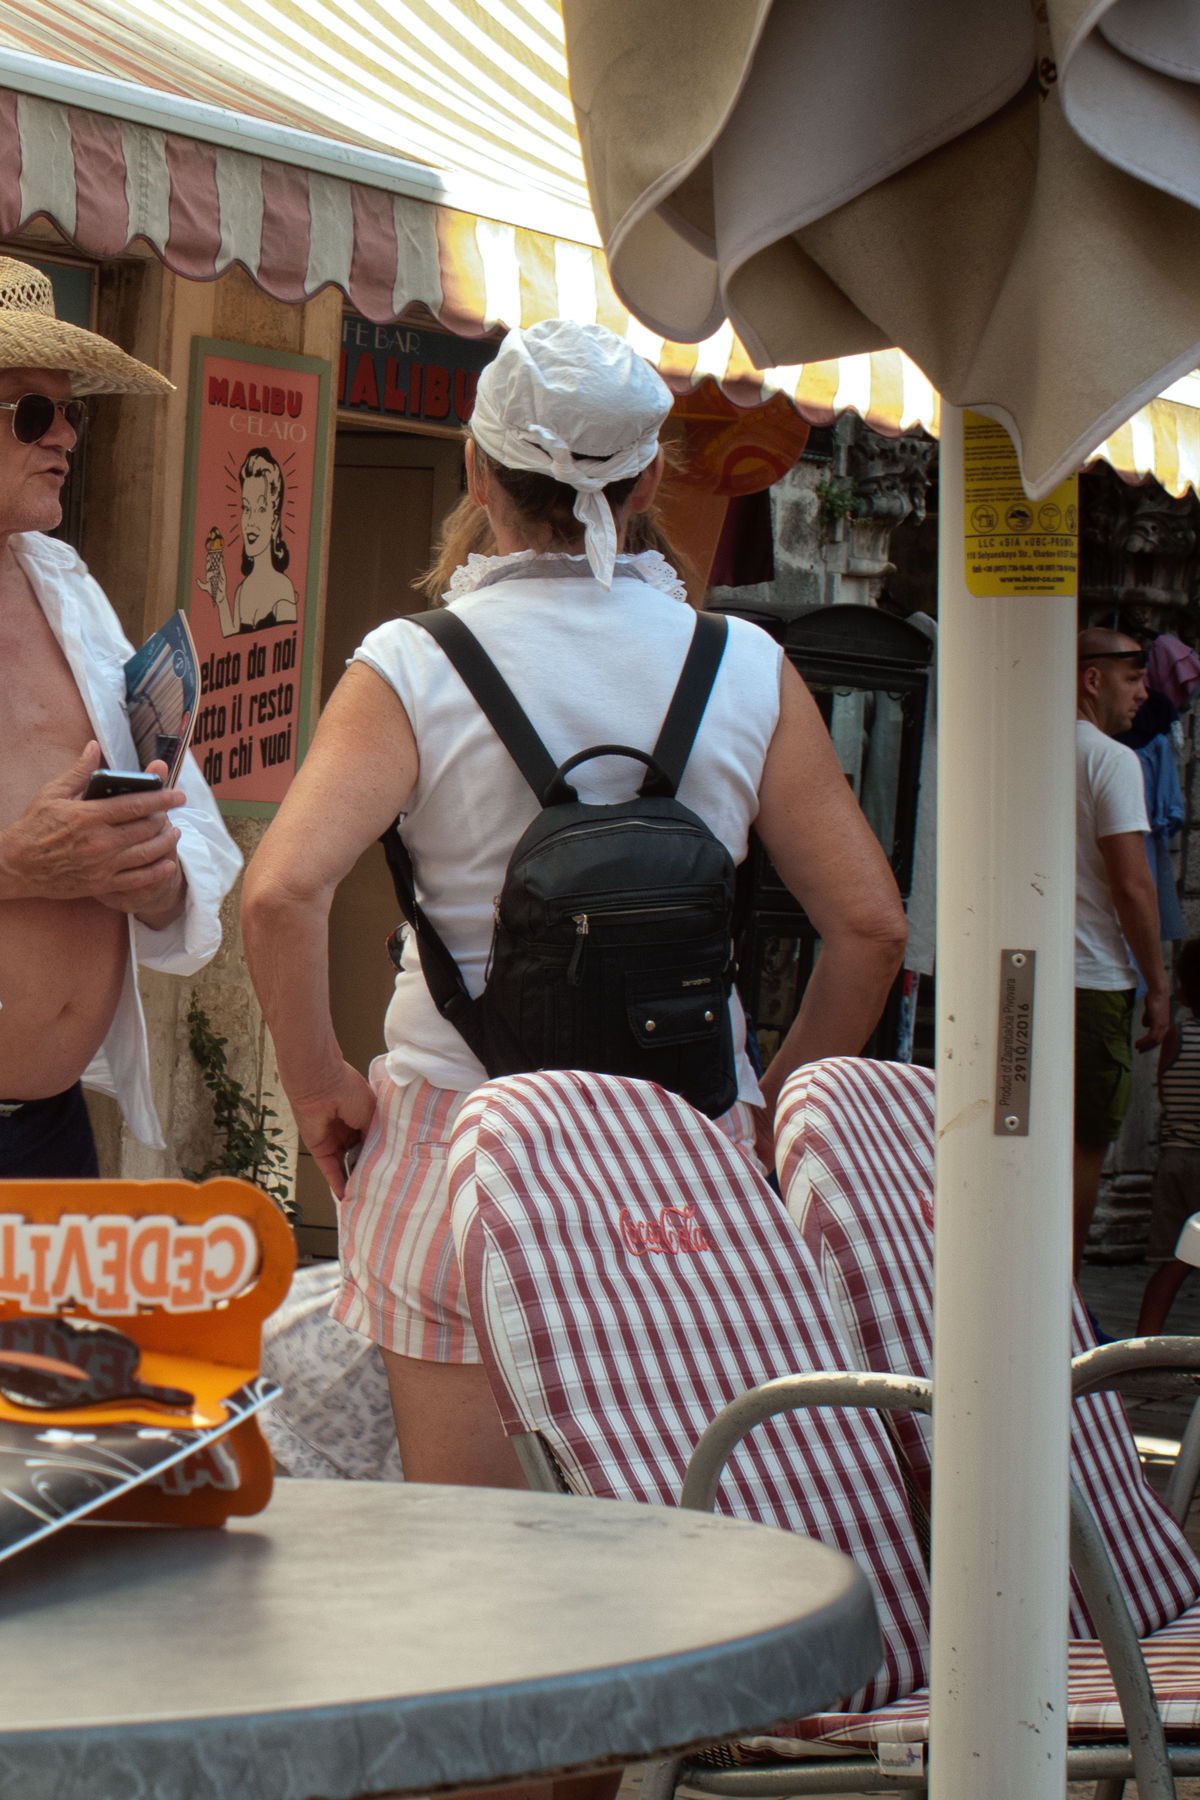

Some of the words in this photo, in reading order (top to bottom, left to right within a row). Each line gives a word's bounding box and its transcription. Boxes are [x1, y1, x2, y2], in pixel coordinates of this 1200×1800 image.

[375, 326, 422, 355] BAR
[208, 376, 303, 418] MALIBU
[337, 348, 481, 424] ALIBU
[230, 413, 307, 443] GELATO
[200, 652, 241, 696] elato
[247, 642, 266, 681] da
[272, 630, 297, 674] noi
[189, 704, 226, 748] utto
[231, 693, 242, 735] il
[249, 683, 293, 727] resto
[204, 747, 222, 787] da
[229, 736, 253, 779] chi
[260, 722, 292, 768] vuoi
[1015, 1003, 1030, 1082] 2910/2016
